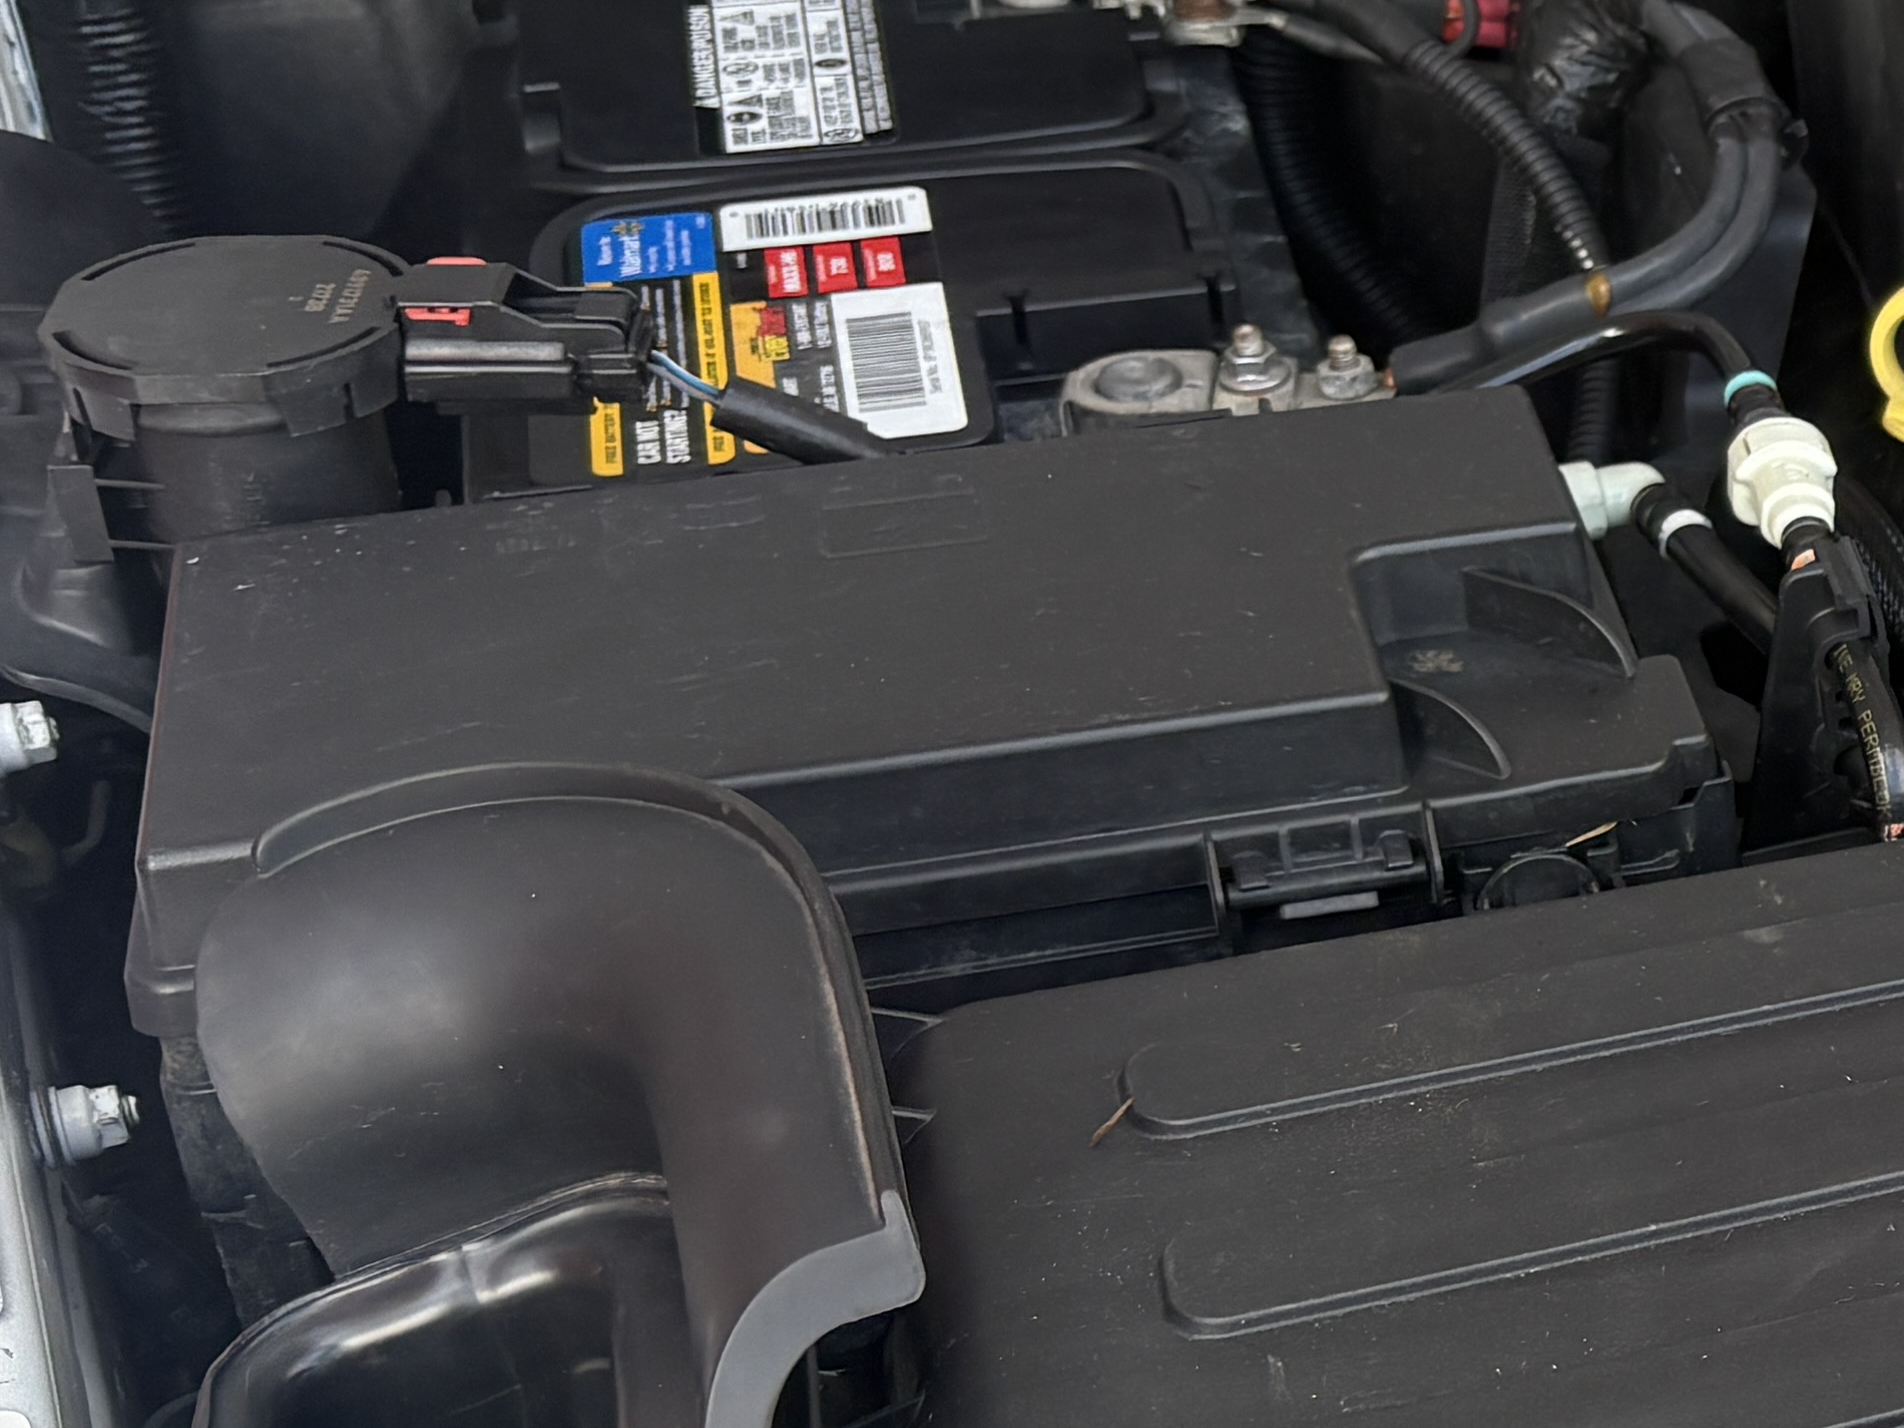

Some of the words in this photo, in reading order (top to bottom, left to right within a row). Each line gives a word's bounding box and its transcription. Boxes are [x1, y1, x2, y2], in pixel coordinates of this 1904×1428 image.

[618, 234, 642, 277] Walmart
[635, 420, 661, 440] NOT
[663, 409, 692, 464] STARTING?
[635, 439, 662, 465] CAR
